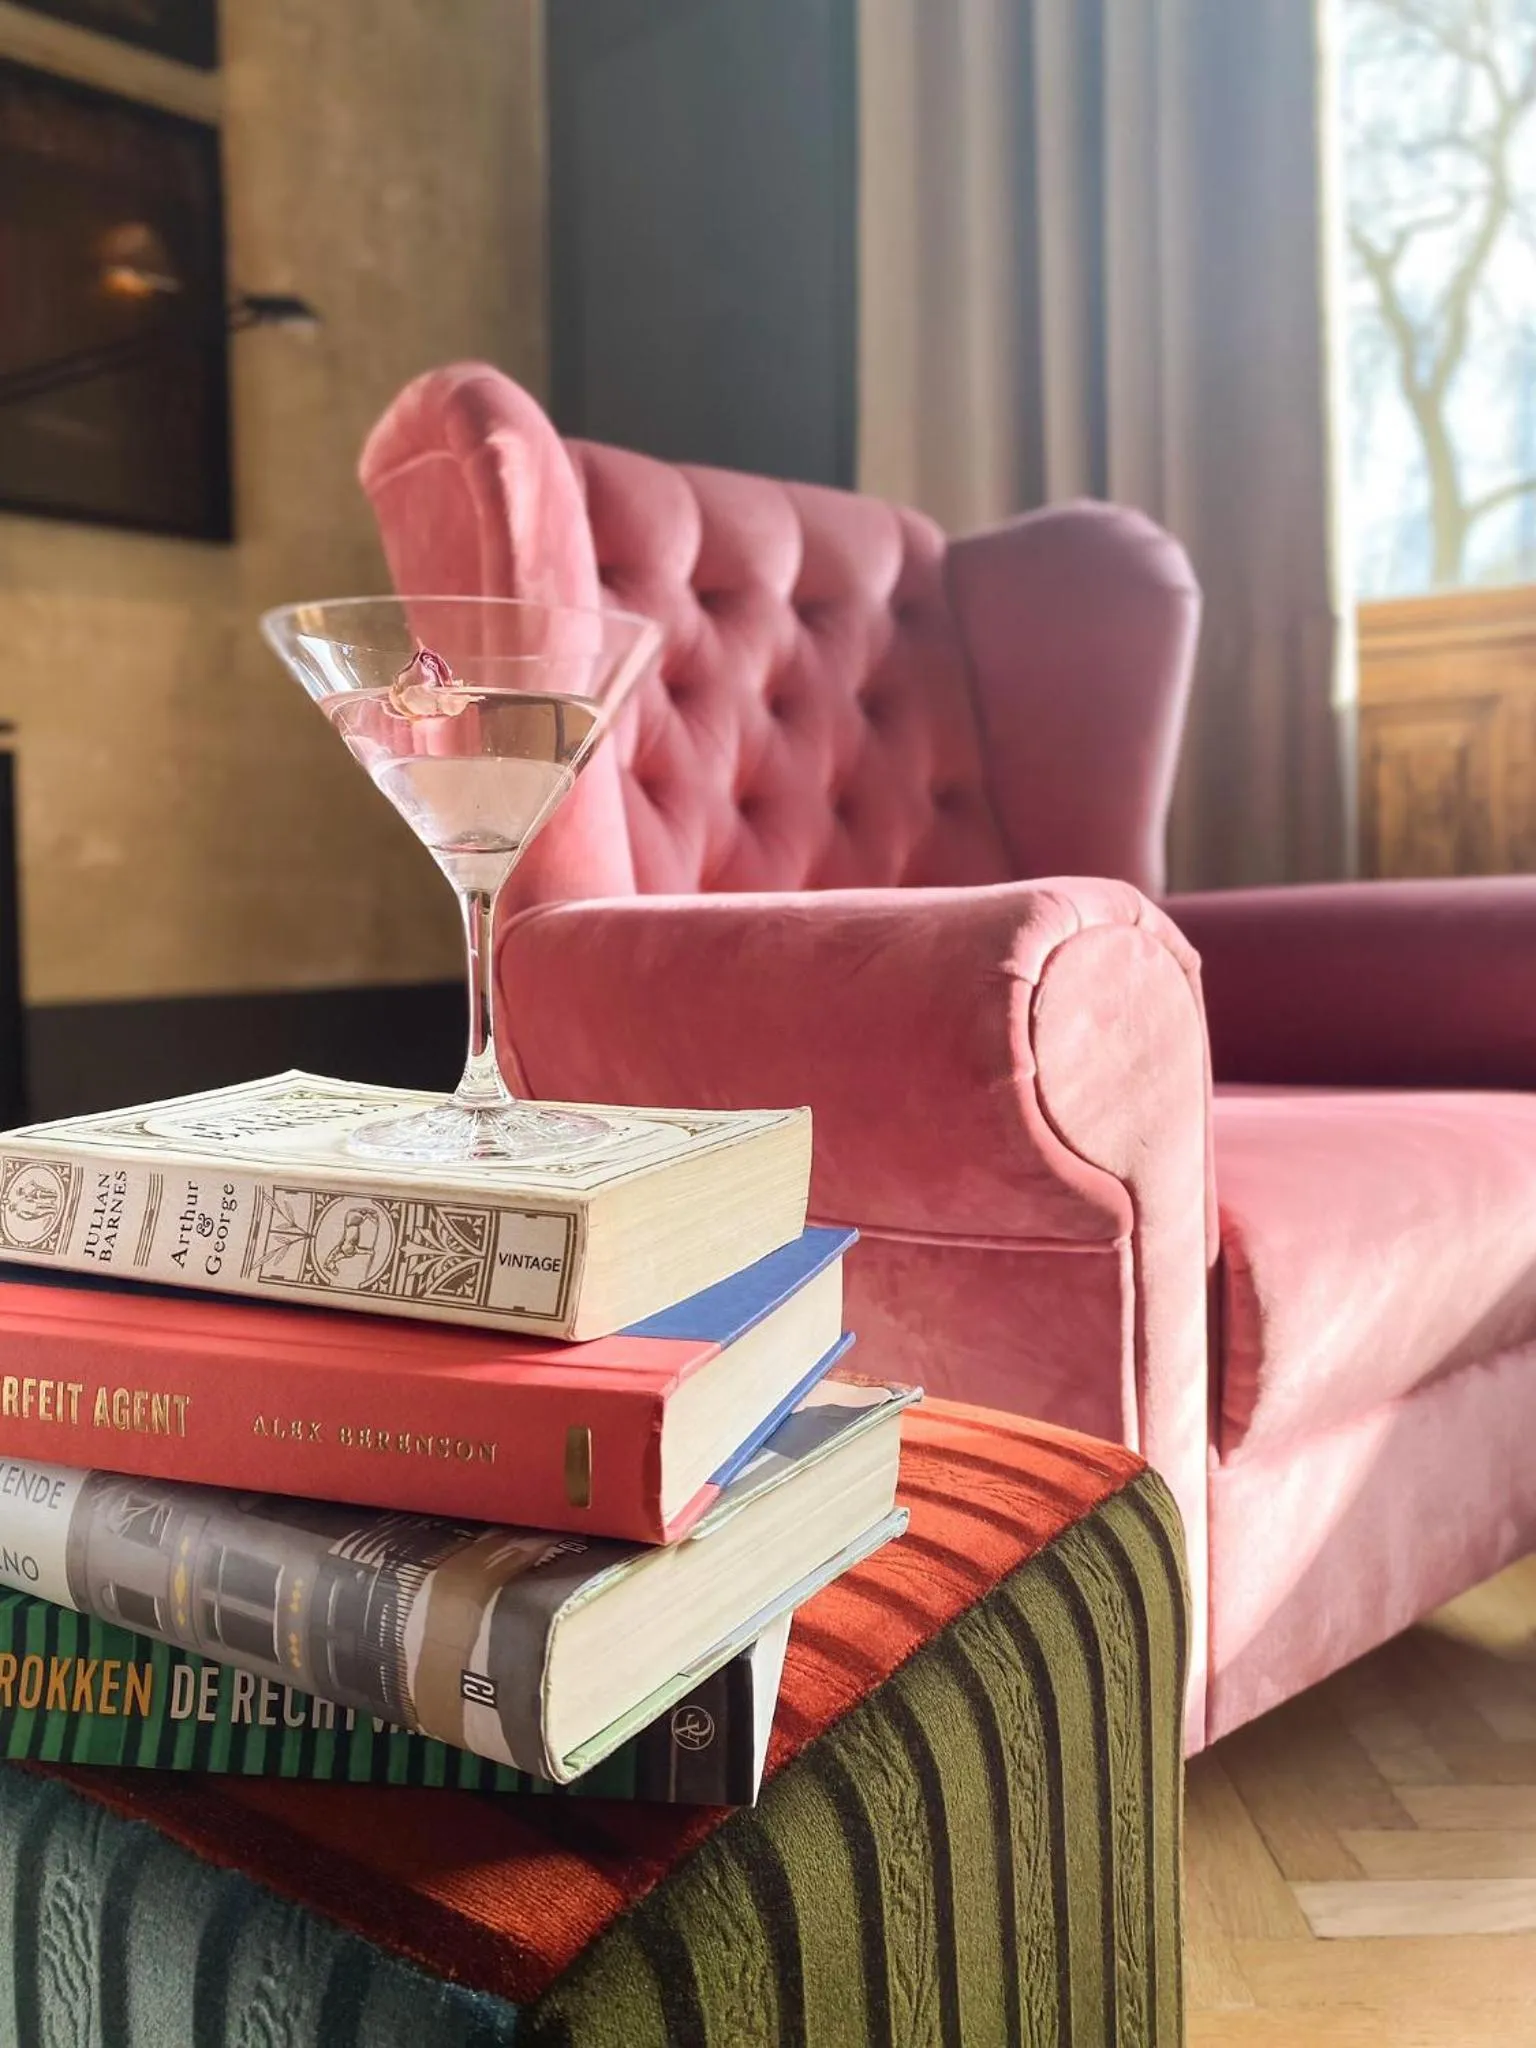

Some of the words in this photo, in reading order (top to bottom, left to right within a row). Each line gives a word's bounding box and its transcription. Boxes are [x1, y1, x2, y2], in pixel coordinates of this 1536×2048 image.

[84, 1173, 110, 1257] JULIAN
[99, 1170, 127, 1262] BARNES
[171, 1181, 199, 1268] Arthur
[196, 1213, 214, 1237] &
[205, 1183, 238, 1275] George
[499, 1252, 562, 1272] VINTAGE
[2, 1375, 83, 1424] RFEIT
[94, 1386, 191, 1437] AGENT
[253, 1415, 322, 1443] ALEX
[339, 1426, 498, 1464] BERENSON
[0, 1462, 66, 1510] ENDE
[170, 1664, 220, 1721] DE
